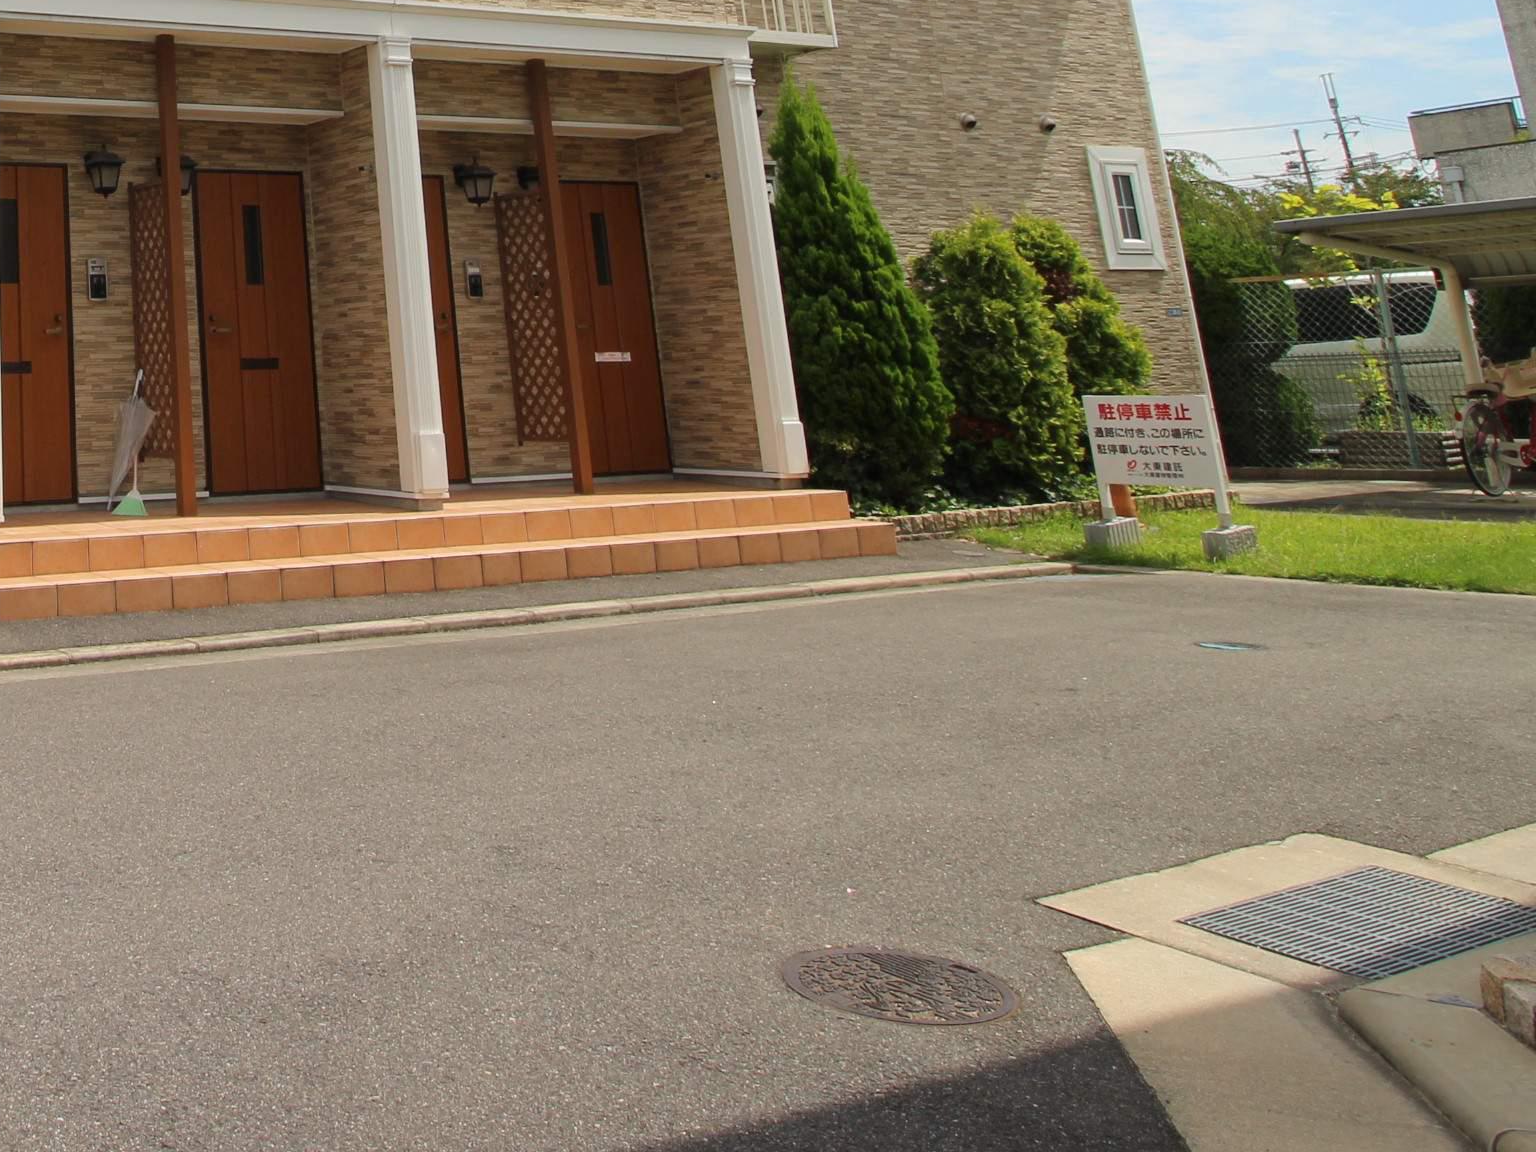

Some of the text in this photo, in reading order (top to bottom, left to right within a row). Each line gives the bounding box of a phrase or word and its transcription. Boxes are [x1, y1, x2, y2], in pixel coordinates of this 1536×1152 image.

[1098, 403, 1192, 421] 駐停車禁止
